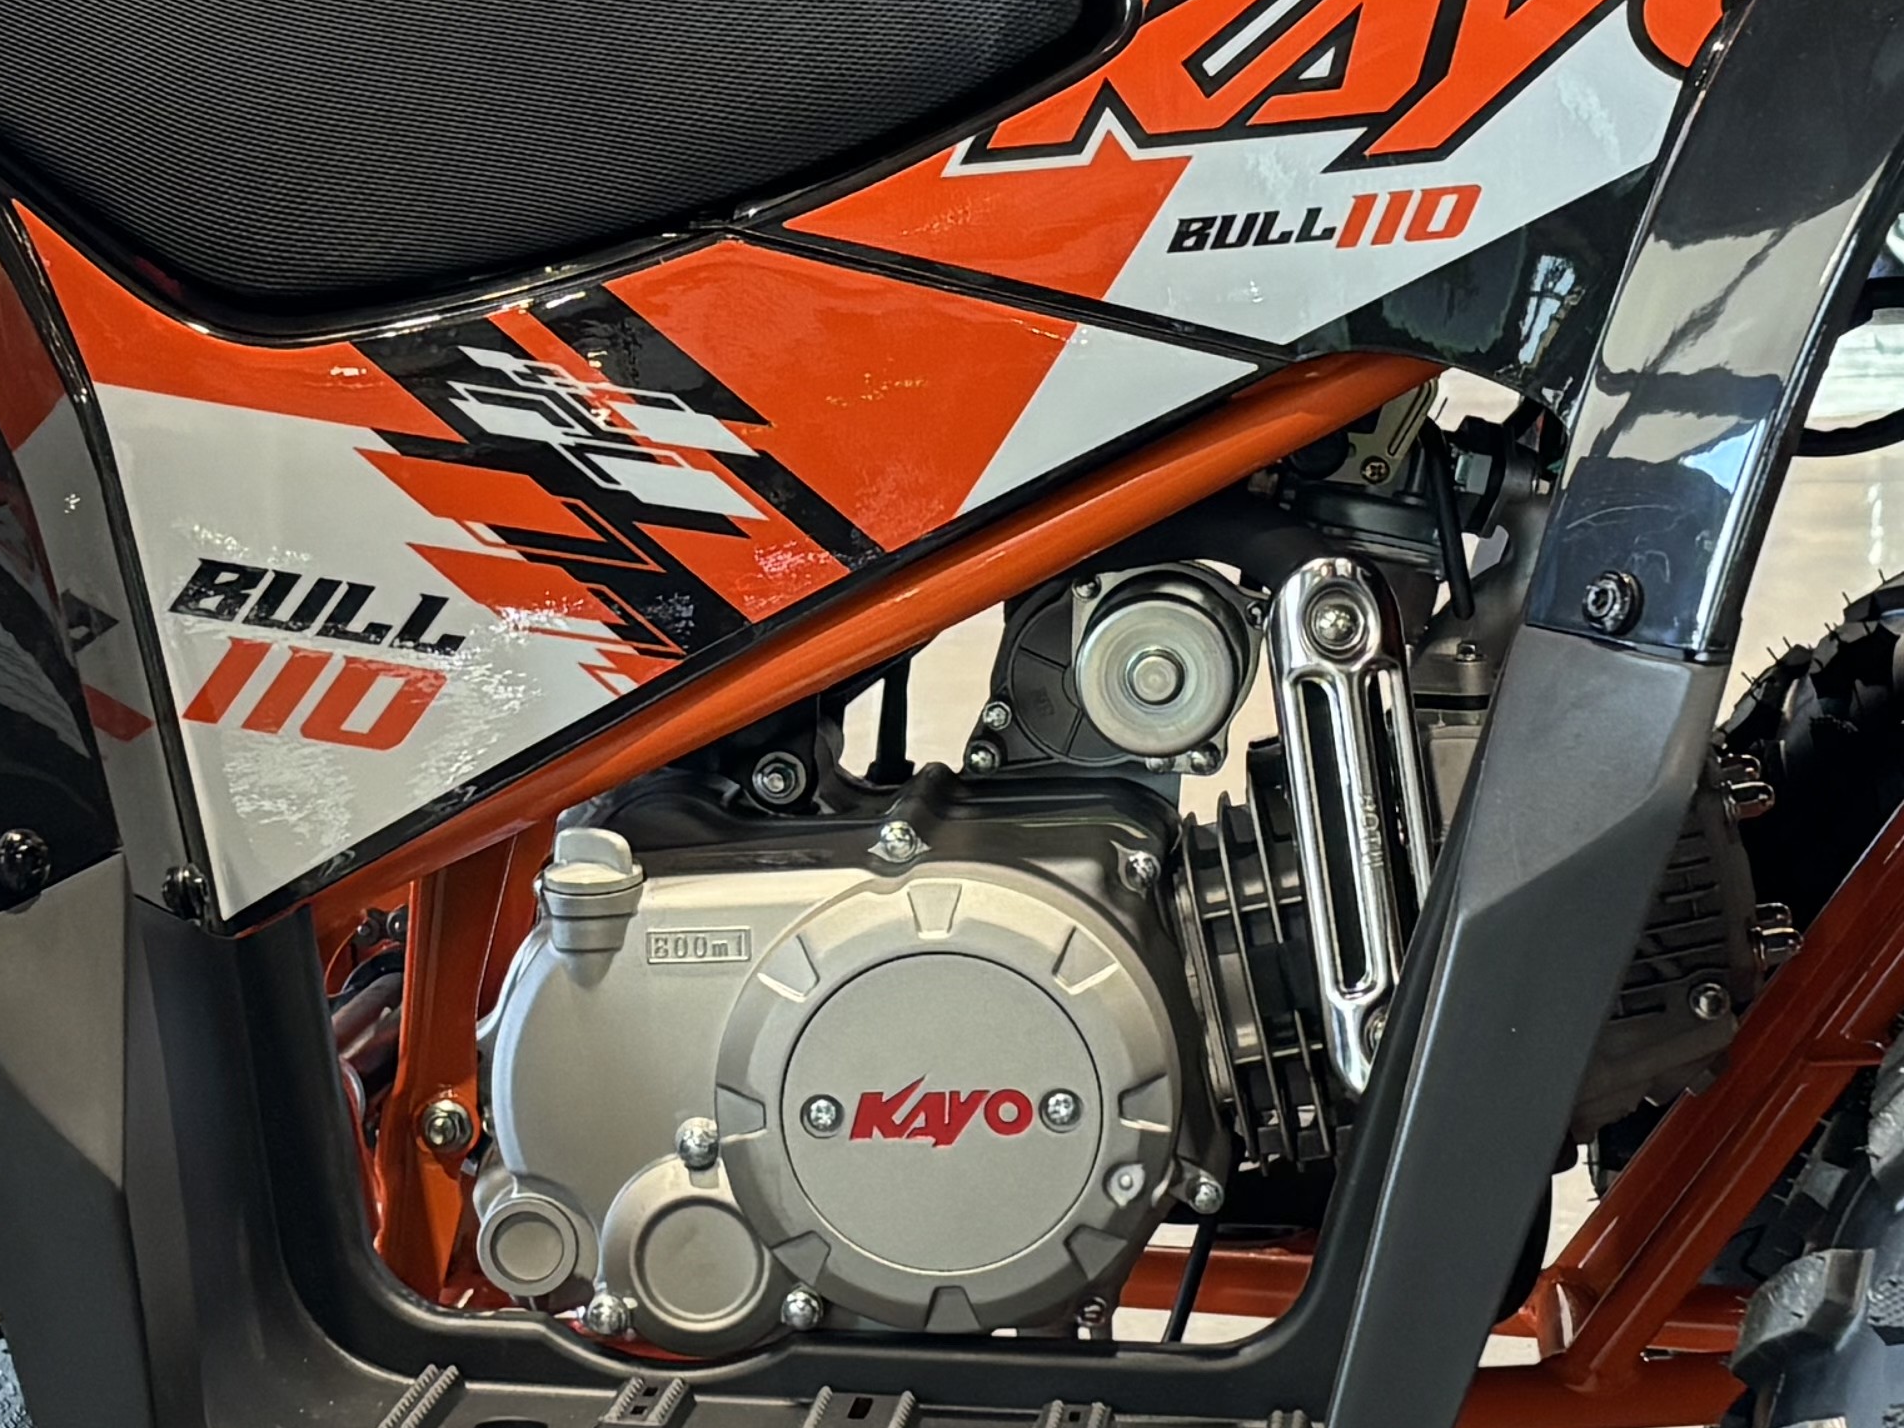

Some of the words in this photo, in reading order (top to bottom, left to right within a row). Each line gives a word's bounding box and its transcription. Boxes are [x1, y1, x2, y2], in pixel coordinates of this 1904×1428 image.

[168, 558, 467, 654] BULL
[181, 636, 448, 751] 110
[849, 1073, 1033, 1148] KAYO
